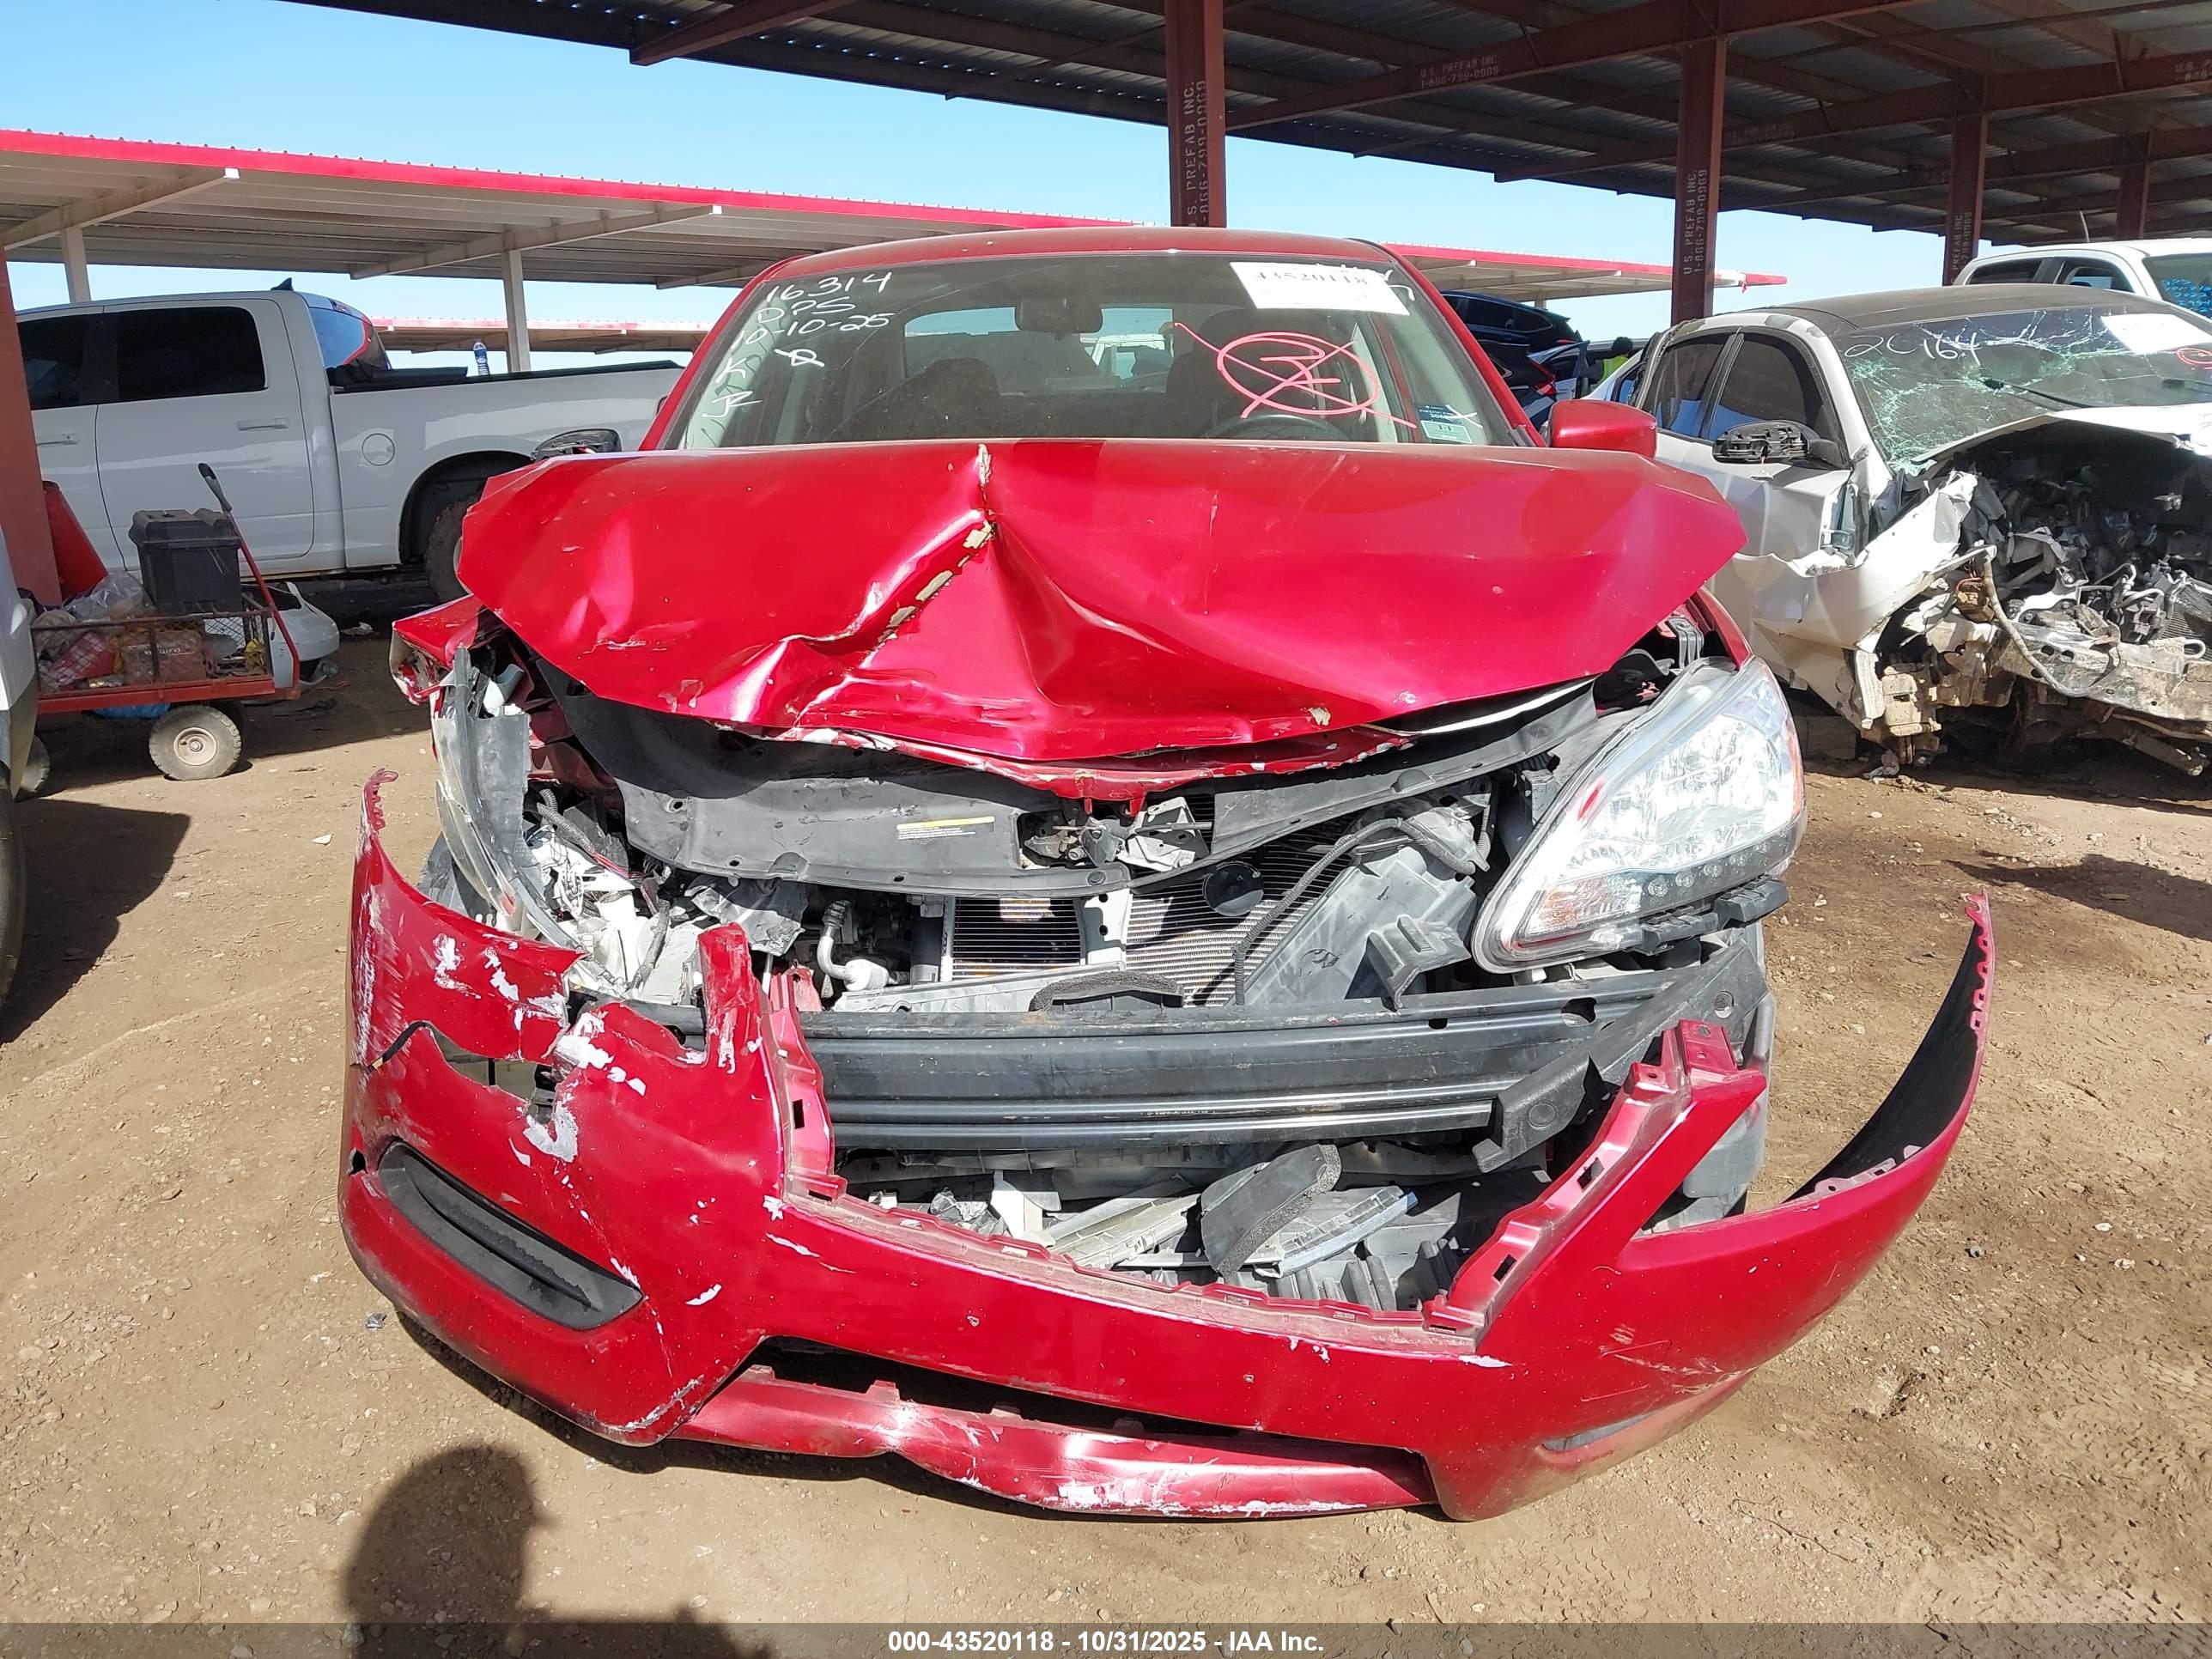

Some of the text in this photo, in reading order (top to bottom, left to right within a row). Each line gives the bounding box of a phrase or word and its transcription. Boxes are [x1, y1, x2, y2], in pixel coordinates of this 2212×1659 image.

[1442, 58, 1478, 74] PREFAB
[1183, 82, 1195, 115] INC.
[1184, 123, 1197, 191] PREFAB
[1196, 81, 1209, 222] -866-799-0969
[1684, 198, 1696, 246] PREFAB
[1693, 169, 1708, 273] 1-866-799-0969
[767, 271, 892, 302] 16314
